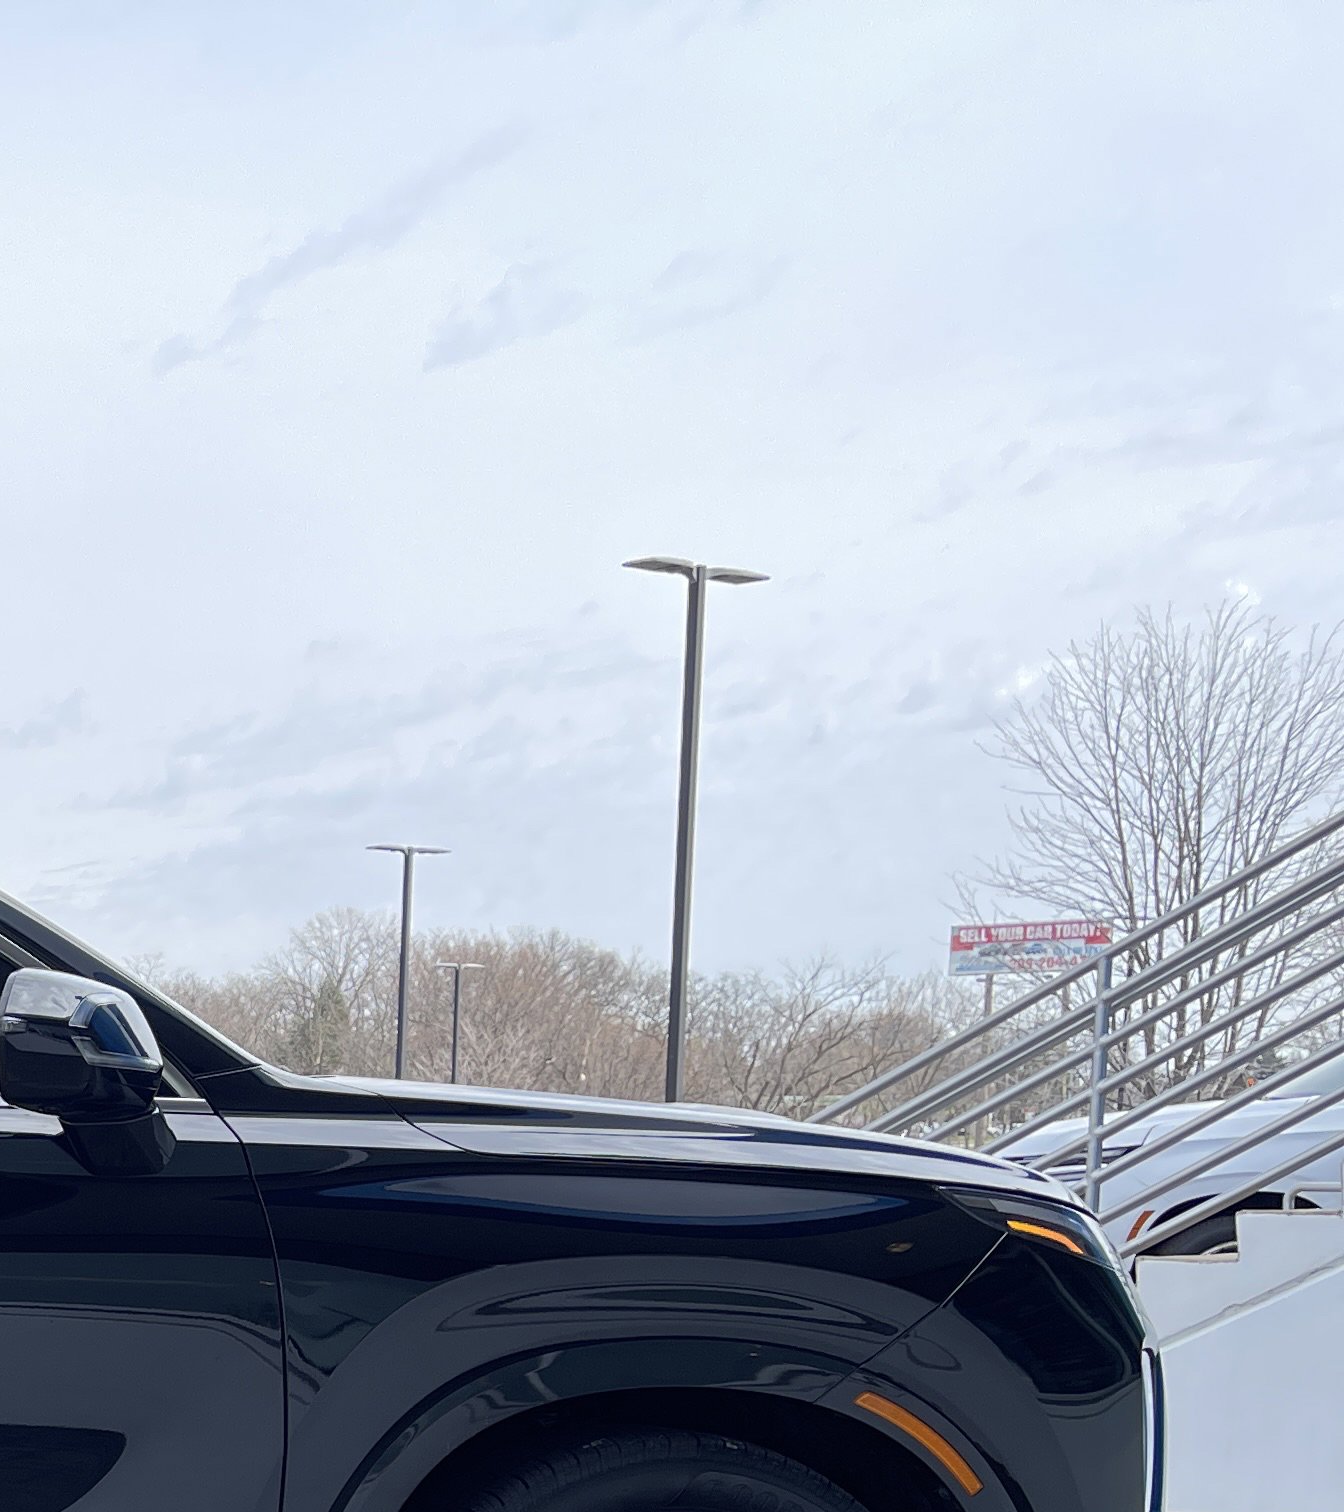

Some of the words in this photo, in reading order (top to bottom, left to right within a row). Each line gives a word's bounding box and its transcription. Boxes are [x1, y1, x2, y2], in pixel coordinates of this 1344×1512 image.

[959, 927, 988, 943] SELL
[991, 925, 1024, 941] YOUR
[1026, 923, 1052, 940] CAR
